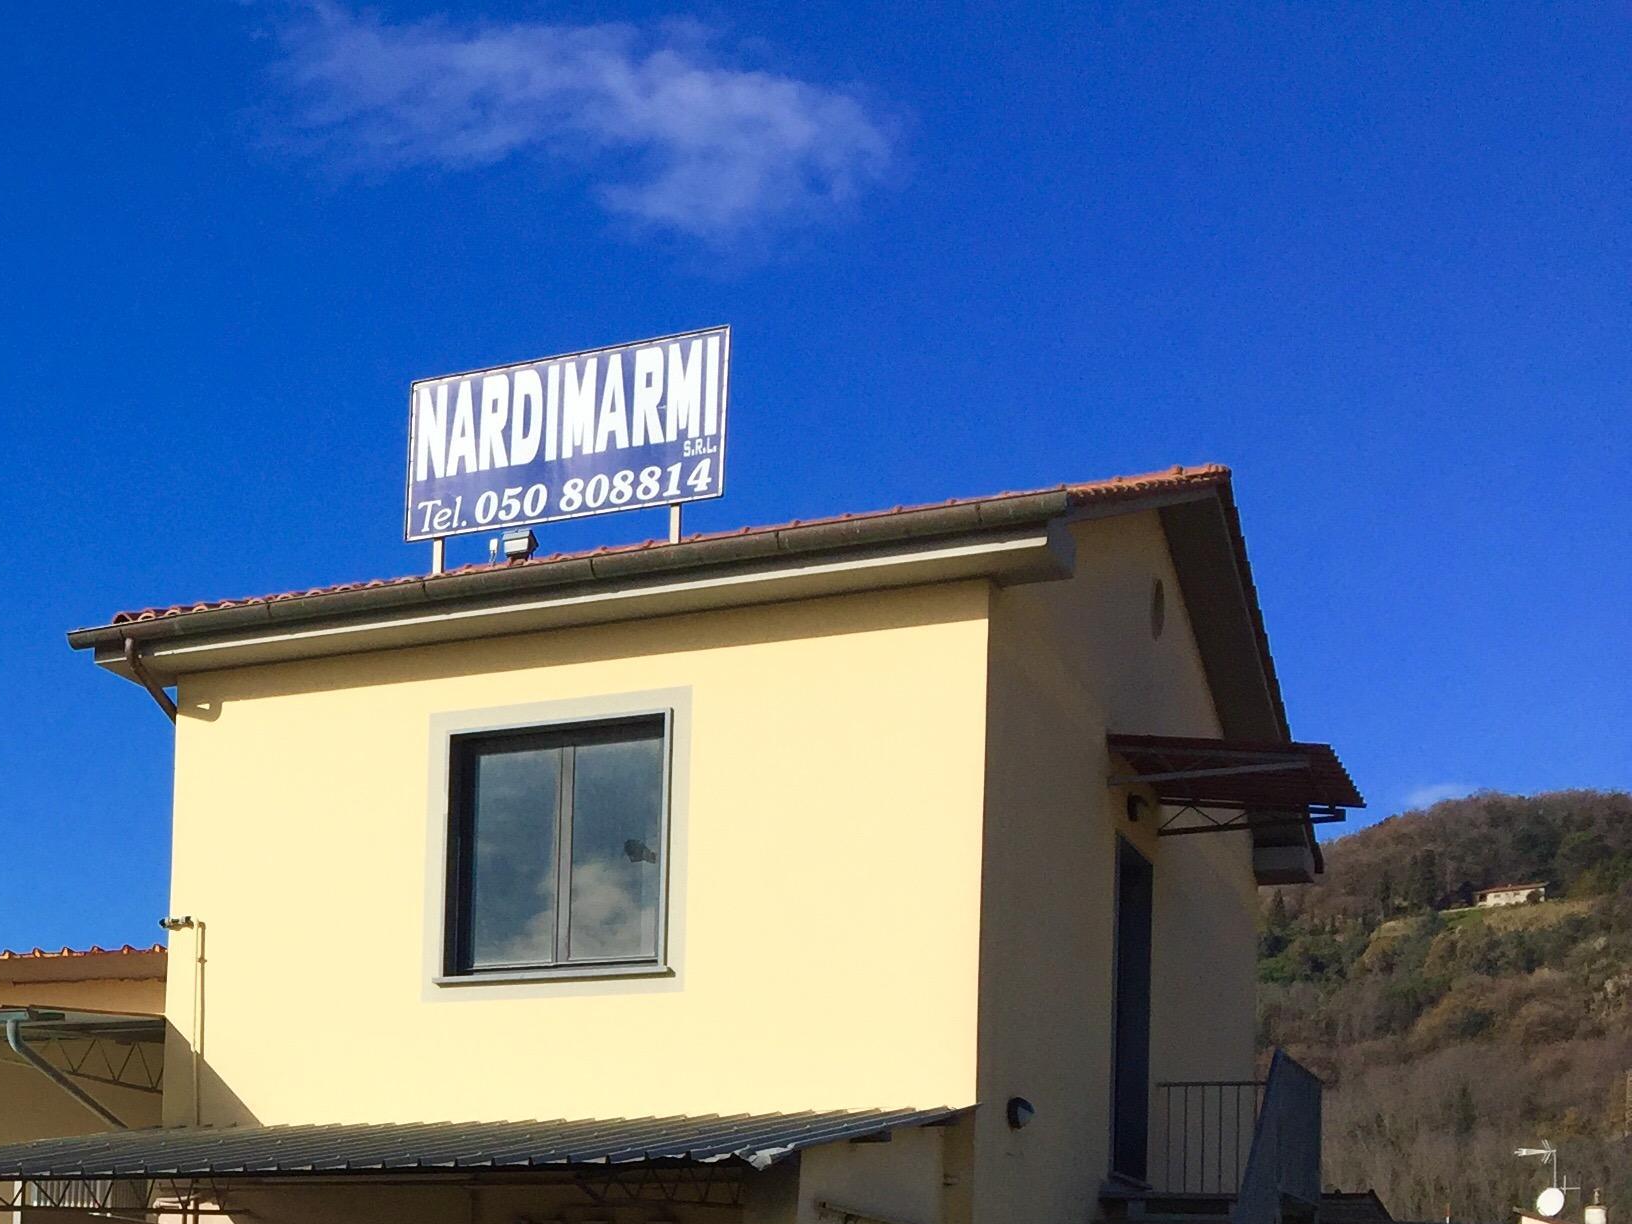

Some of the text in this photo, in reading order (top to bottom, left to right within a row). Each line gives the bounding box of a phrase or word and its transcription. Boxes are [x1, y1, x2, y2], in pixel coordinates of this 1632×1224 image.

[683, 439, 717, 457] S.R.L.
[417, 458, 712, 533] Tel. 050 808814
